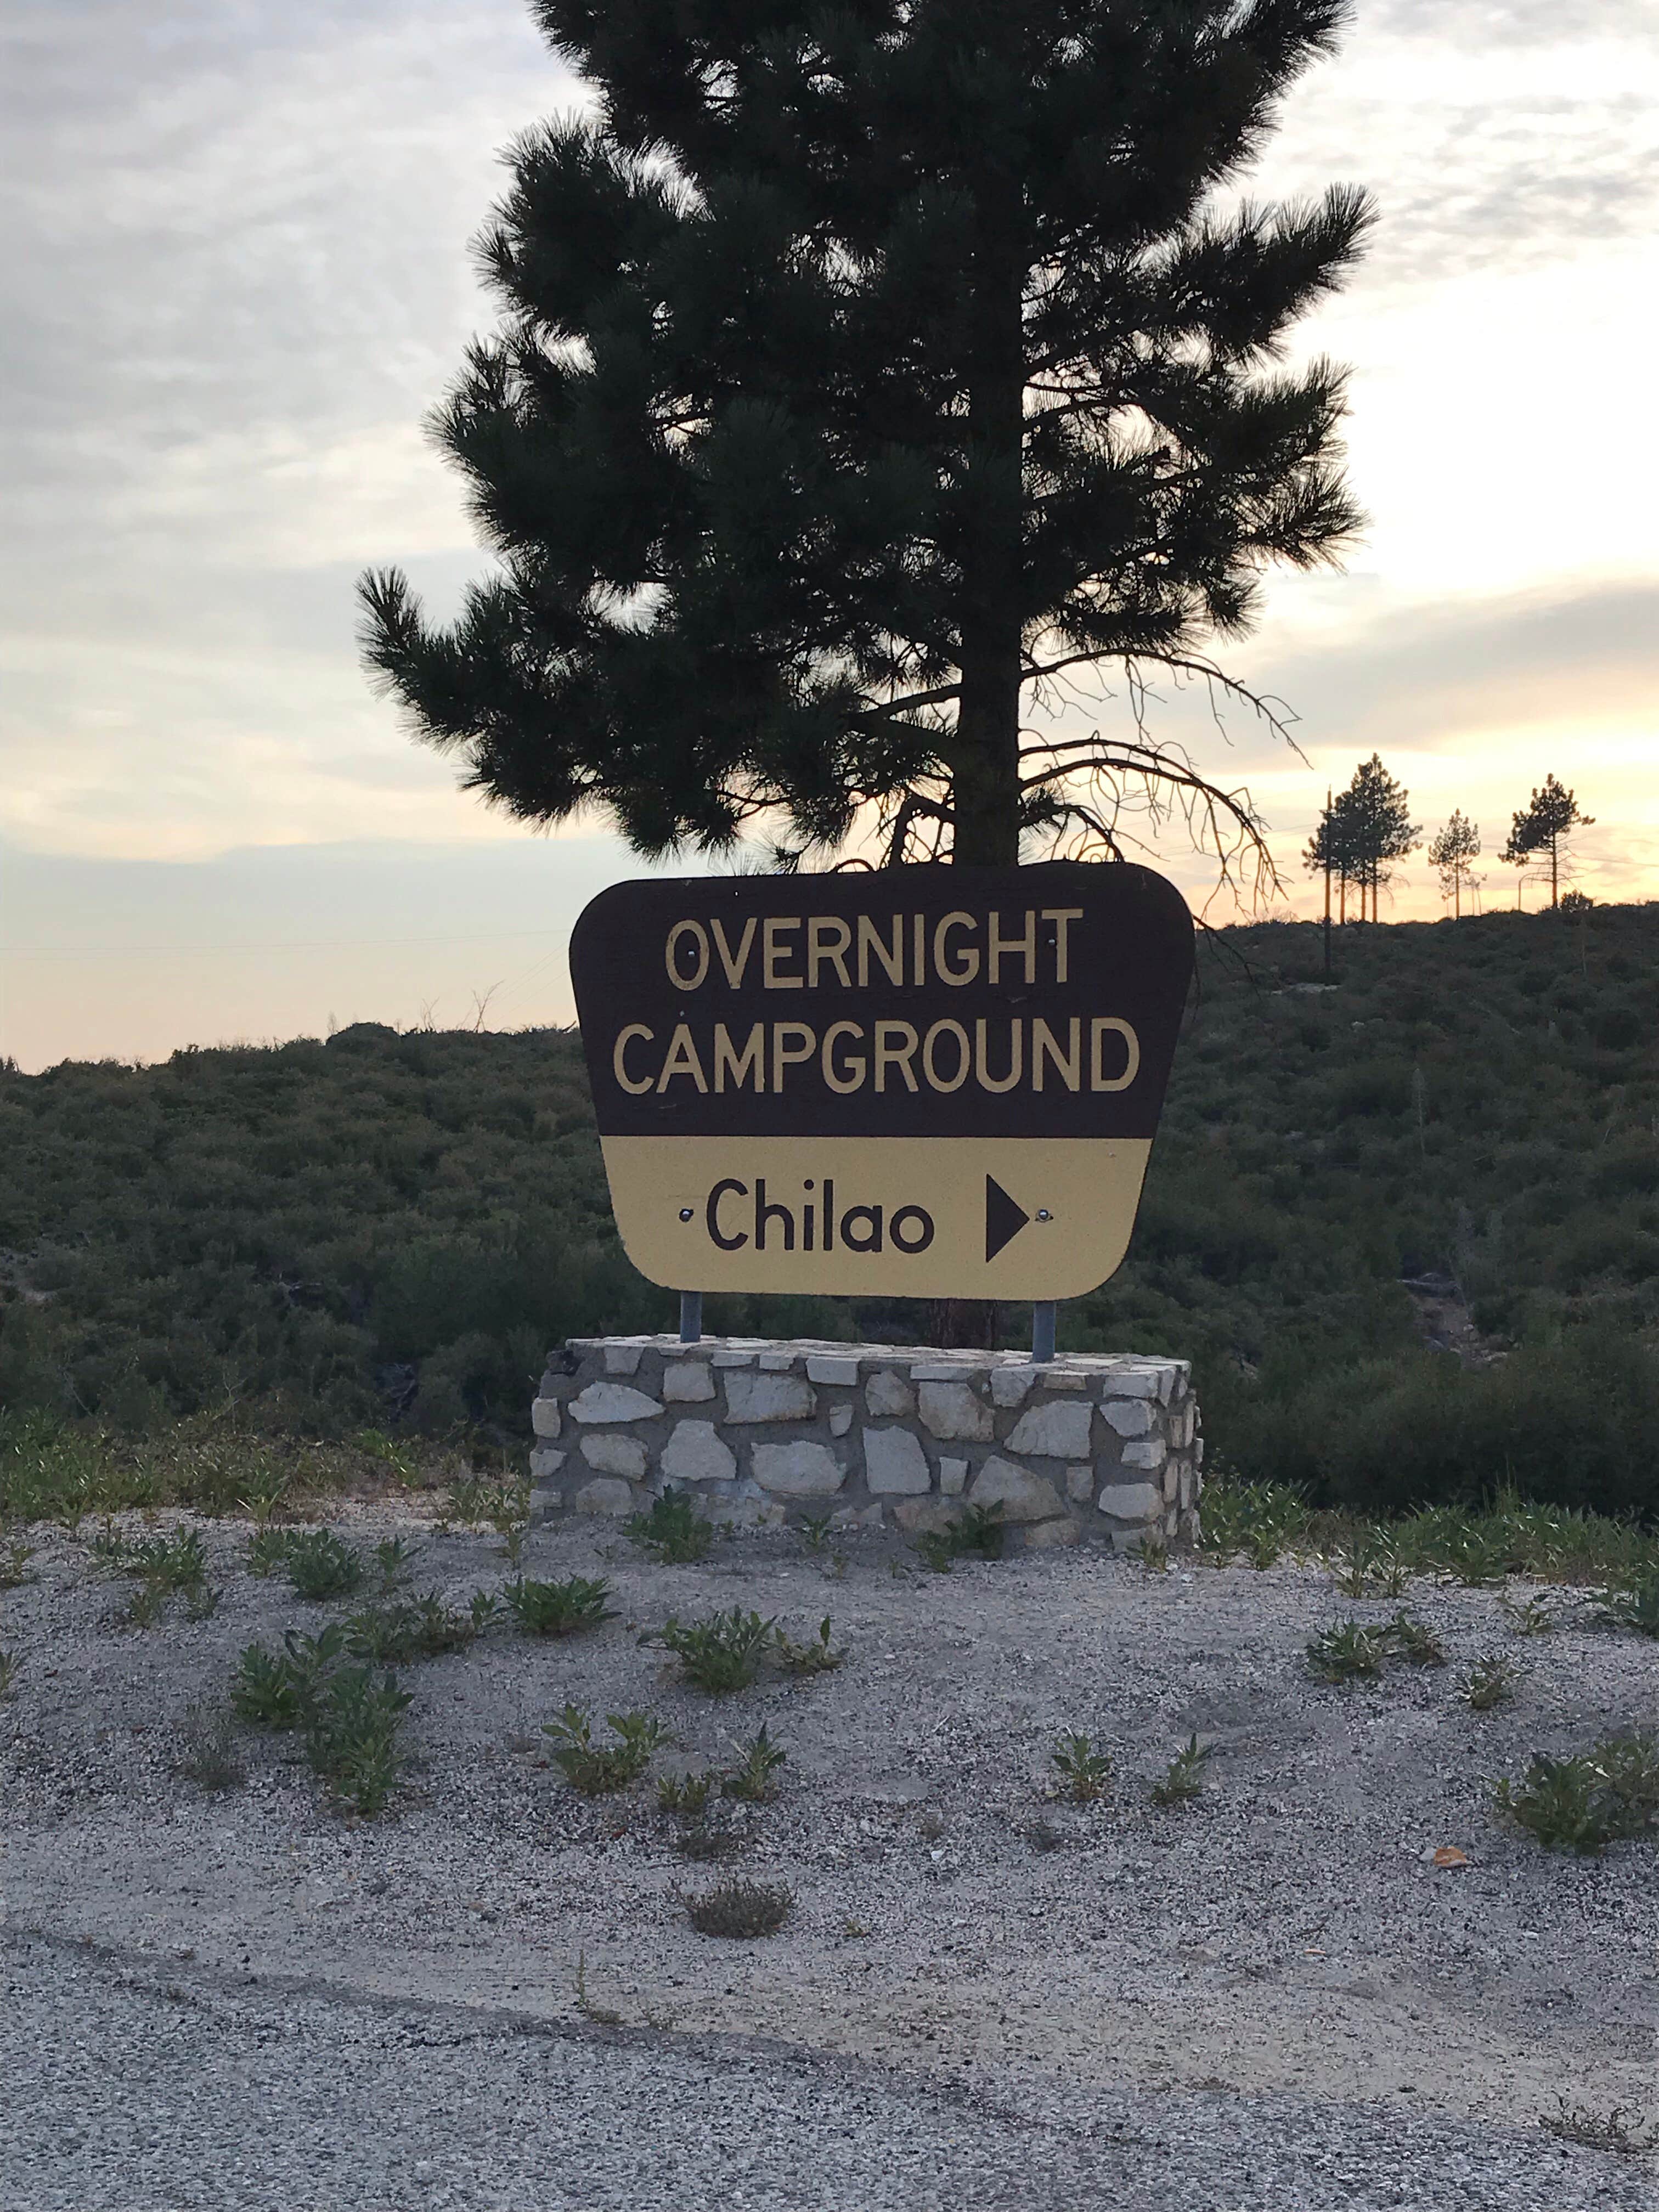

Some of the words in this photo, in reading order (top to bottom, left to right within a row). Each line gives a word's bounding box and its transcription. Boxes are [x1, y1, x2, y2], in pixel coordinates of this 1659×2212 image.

[664, 908, 1084, 990] OVERNIGHT
[613, 1017, 1141, 1095] CAMPGROUND
[706, 1178, 935, 1254] Chilao
